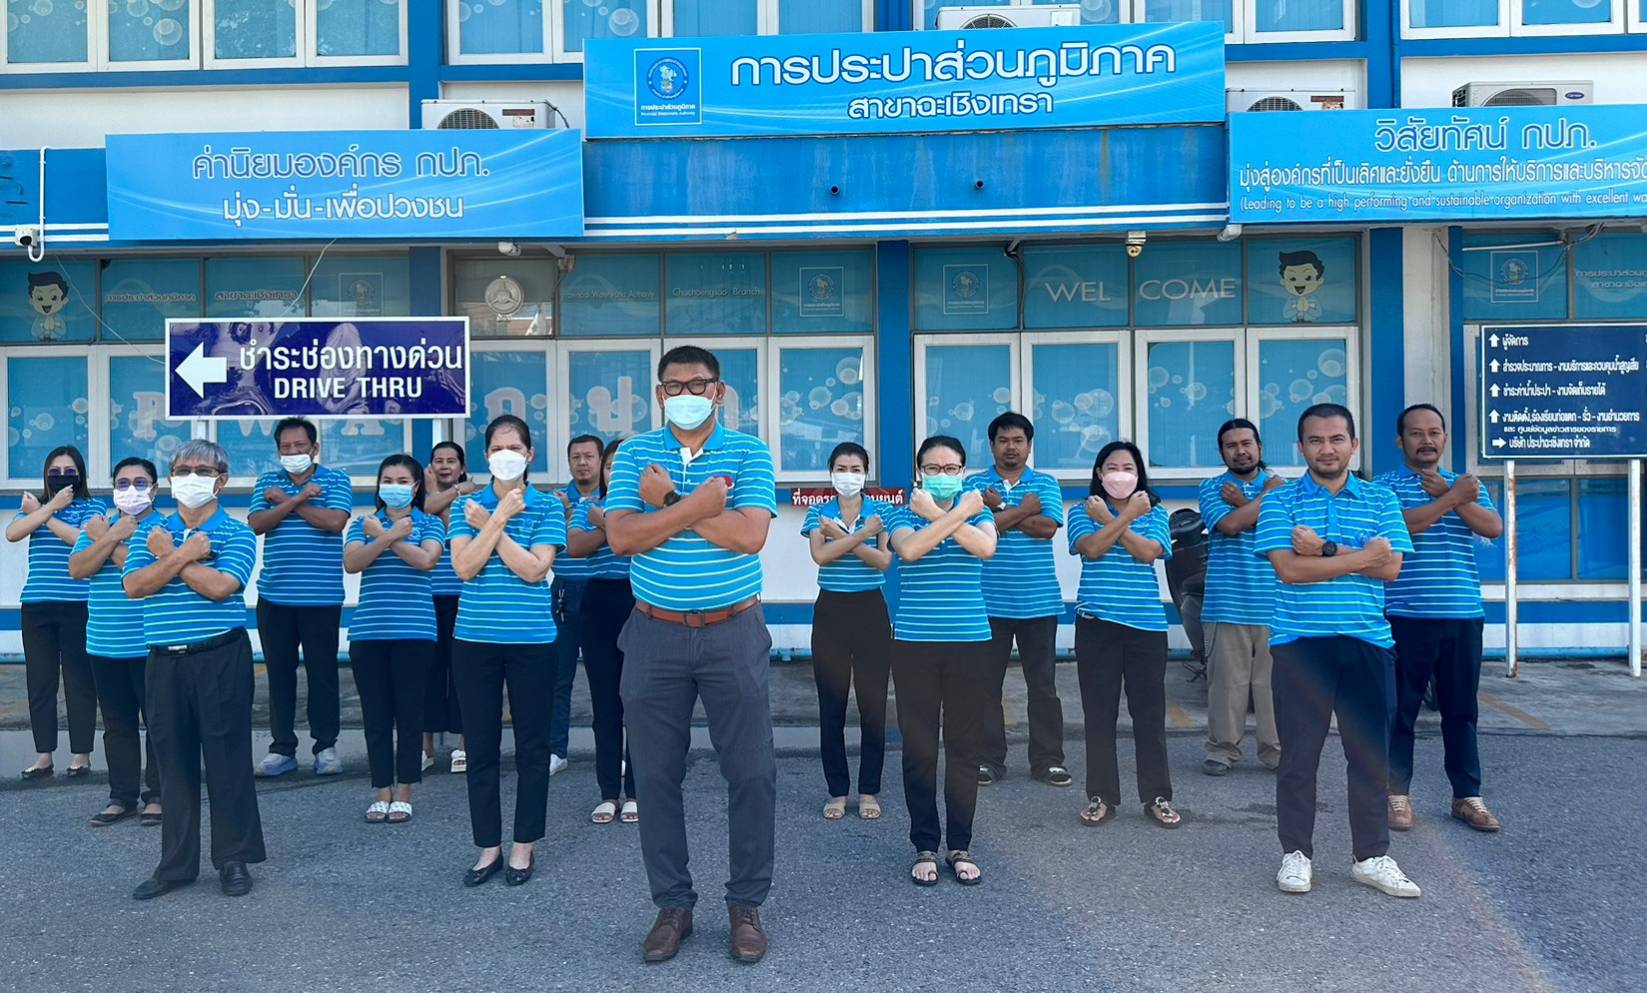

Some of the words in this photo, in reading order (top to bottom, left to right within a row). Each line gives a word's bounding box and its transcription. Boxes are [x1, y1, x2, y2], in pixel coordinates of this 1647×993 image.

[731, 39, 1176, 87] การประปาส่วนภูมิภาค
[848, 91, 1053, 119] สาขาฉะเชิงเทรา
[1375, 117, 1510, 152] วิสัยทัศน์
[1521, 117, 1597, 150] กปภ.
[193, 146, 402, 179] ค่านิยมองค์กร
[416, 147, 490, 177] กปภ.
[1239, 156, 1441, 192] มุ่งสู่องค์กรที่เป็นเลิศและยั่งยืน
[223, 184, 464, 227] มุ่ง-มั่น-เพื่อปวงชน
[1240, 196, 1282, 213] (Leading
[1287, 197, 1296, 208] to
[1300, 196, 1312, 208] be
[1316, 199, 1324, 208] a
[1328, 193, 1349, 212] high
[1354, 193, 1408, 212] performing
[1412, 192, 1431, 208] and
[1436, 190, 1489, 207] sustainable
[1494, 191, 1556, 209] organization
[1561, 190, 1581, 204] with
[1586, 189, 1629, 204] excellent
[1045, 281, 1112, 302] WEL
[1139, 277, 1237, 301] COME
[239, 338, 463, 370] ชำระช่องทางด่วน
[274, 378, 345, 399] DRIVE
[356, 377, 422, 398] THRU
